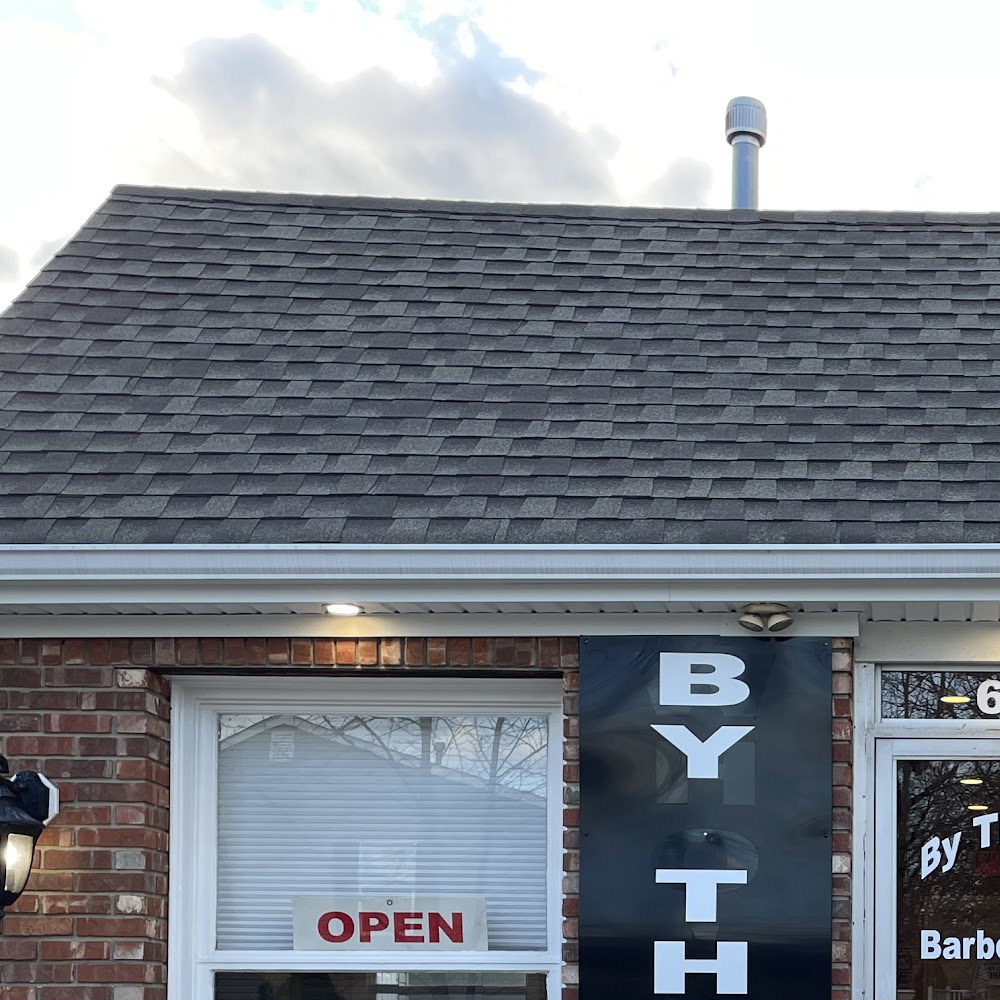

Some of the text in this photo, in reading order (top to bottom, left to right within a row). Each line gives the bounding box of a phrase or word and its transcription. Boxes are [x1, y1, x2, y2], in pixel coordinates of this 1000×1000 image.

[650, 652, 755, 779] BY
[921, 831, 962, 880] By
[318, 911, 463, 943] OPEN
